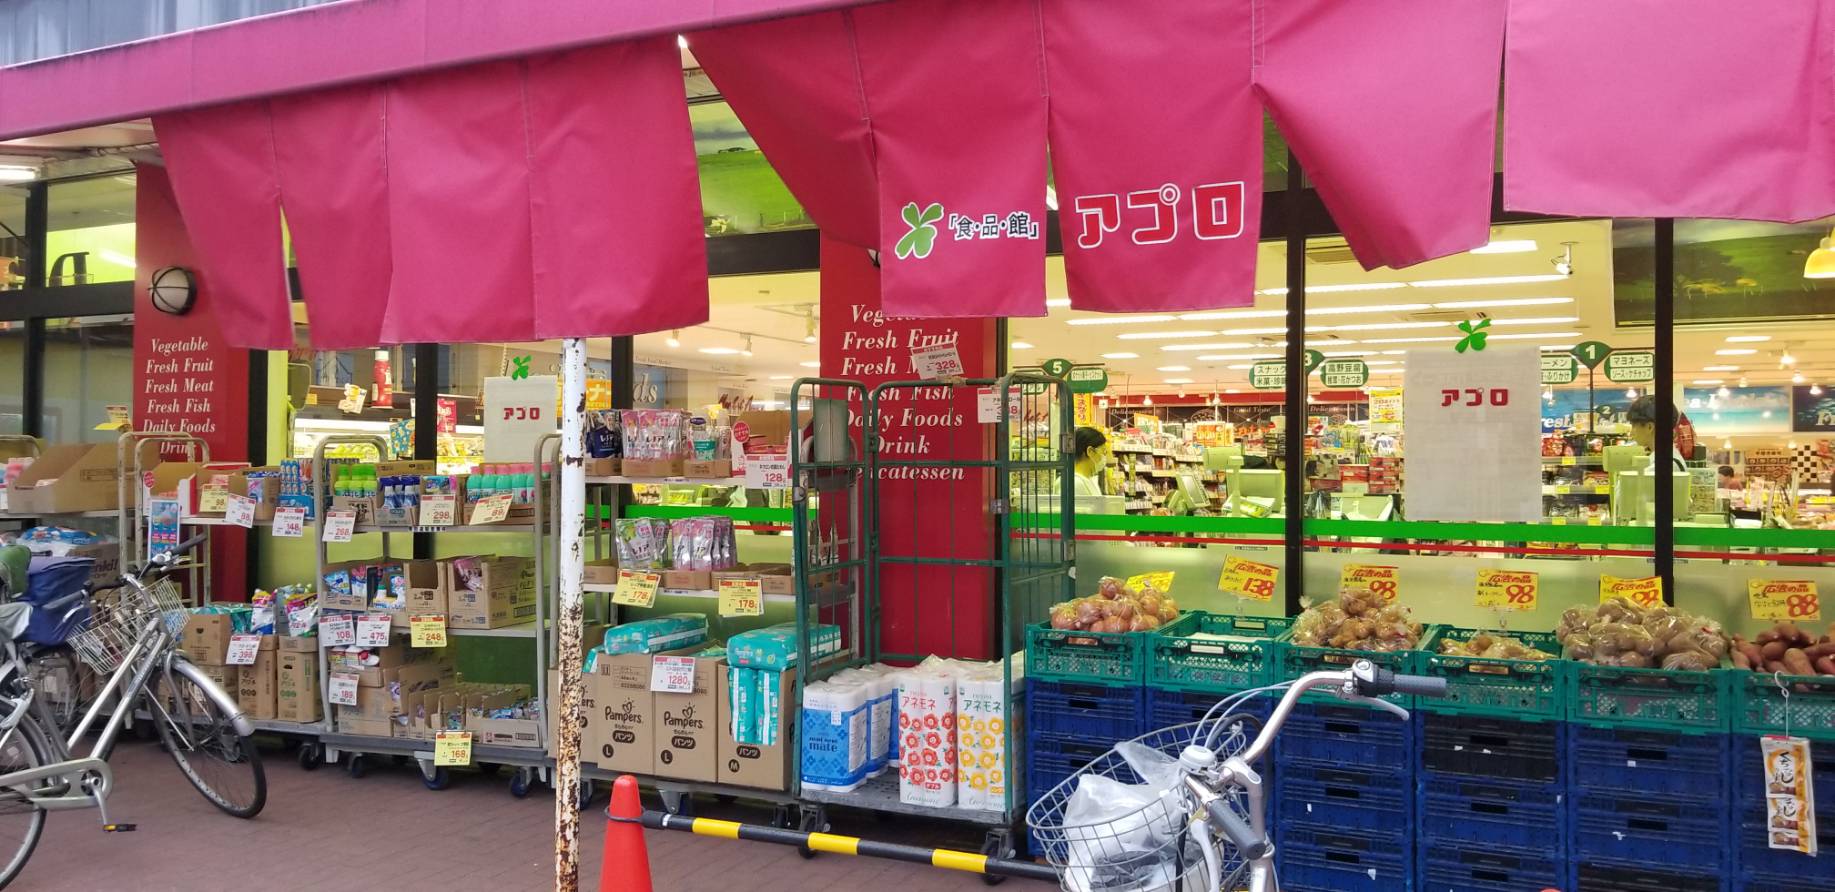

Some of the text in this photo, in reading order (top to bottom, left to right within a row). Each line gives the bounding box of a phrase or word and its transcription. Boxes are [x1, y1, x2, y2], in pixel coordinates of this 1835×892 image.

[1074, 180, 1245, 250] アプロ
[151, 336, 209, 356] Vegetable
[842, 328, 960, 351] Fresh Fruit
[1585, 344, 1596, 359] 1
[145, 357, 214, 374] Fresh Fruit
[840, 357, 898, 376] Fresh
[935, 359, 957, 370] 328
[1052, 361, 1063, 374] 5
[1542, 358, 1568, 368] ーメン
[1613, 355, 1651, 365] マヨネーズ
[144, 377, 214, 394] Fresh Meat
[1441, 387, 1509, 406] アプロ
[146, 397, 211, 414] Fresh Fish
[504, 406, 540, 420] アプロ
[900, 406, 963, 427] Foods
[143, 418, 216, 433] Daily Foods
[764, 473, 783, 483] 128
[855, 466, 965, 481] eicatessen
[1243, 577, 1274, 597] 138
[1369, 580, 1398, 600] 98
[1505, 584, 1535, 605] 98
[631, 590, 648, 600] 178
[738, 599, 756, 609] 178
[1786, 594, 1818, 617] 88
[336, 631, 350, 640] 108
[370, 632, 386, 641] 475
[425, 632, 442, 642] 248
[667, 674, 688, 685] 1280
[901, 695, 936, 711] アネモネ
[963, 699, 1002, 713] アネモネ
[604, 705, 642, 725] Pampers
[663, 710, 704, 730] Pampers
[614, 732, 633, 742] パンツ
[674, 738, 694, 748] パンツ
[451, 750, 466, 759] 168
[738, 747, 758, 757] パンツ
